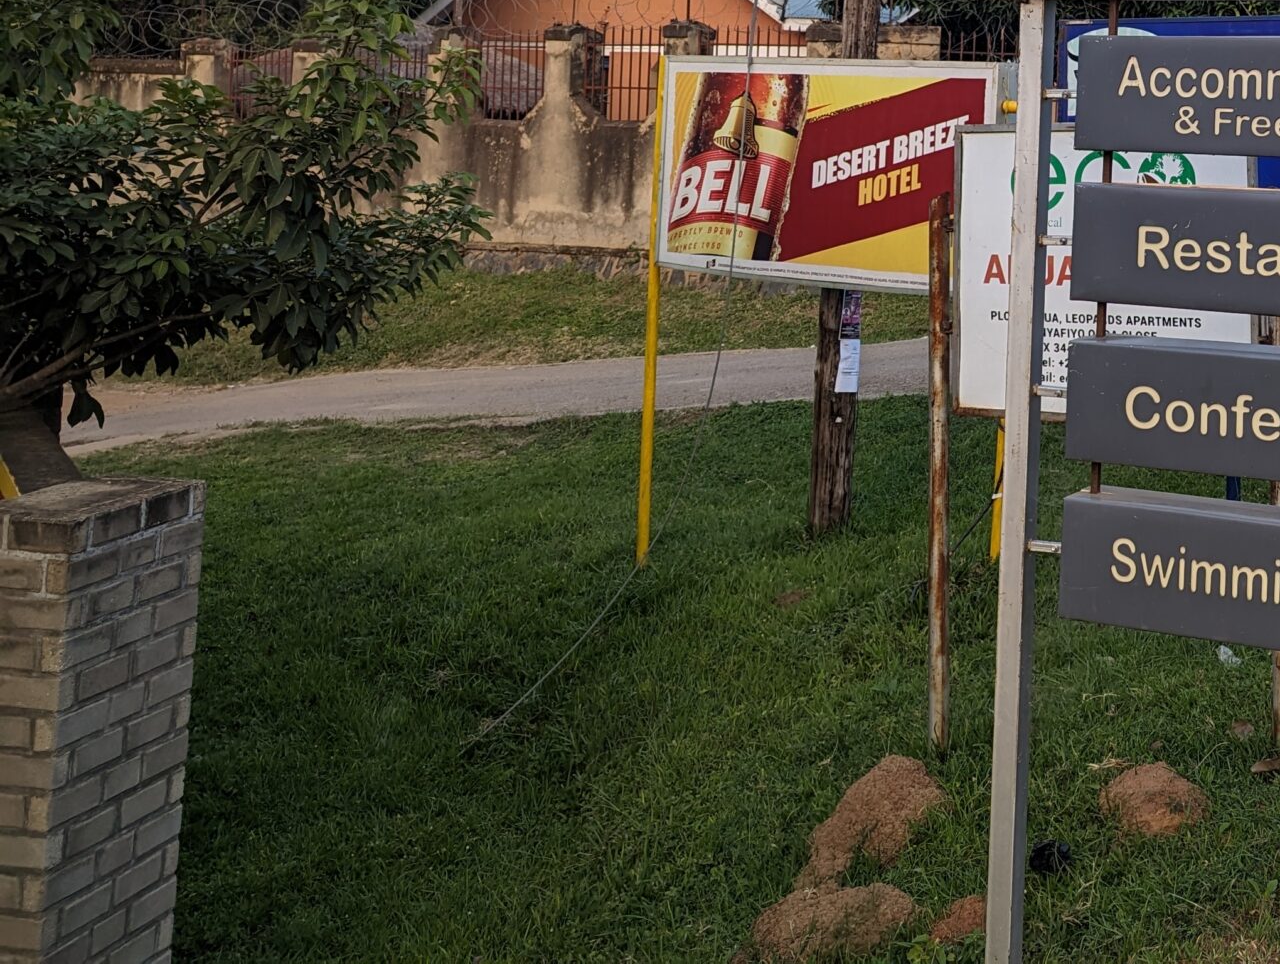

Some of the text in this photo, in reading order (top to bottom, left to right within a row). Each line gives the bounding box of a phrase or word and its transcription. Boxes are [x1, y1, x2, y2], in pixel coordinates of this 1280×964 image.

[1174, 105, 1201, 135] &
[811, 139, 890, 189] DESERT
[858, 164, 921, 207] HOTEL
[670, 159, 772, 223] BELL
[1126, 315, 1202, 328] APARTMENTS
